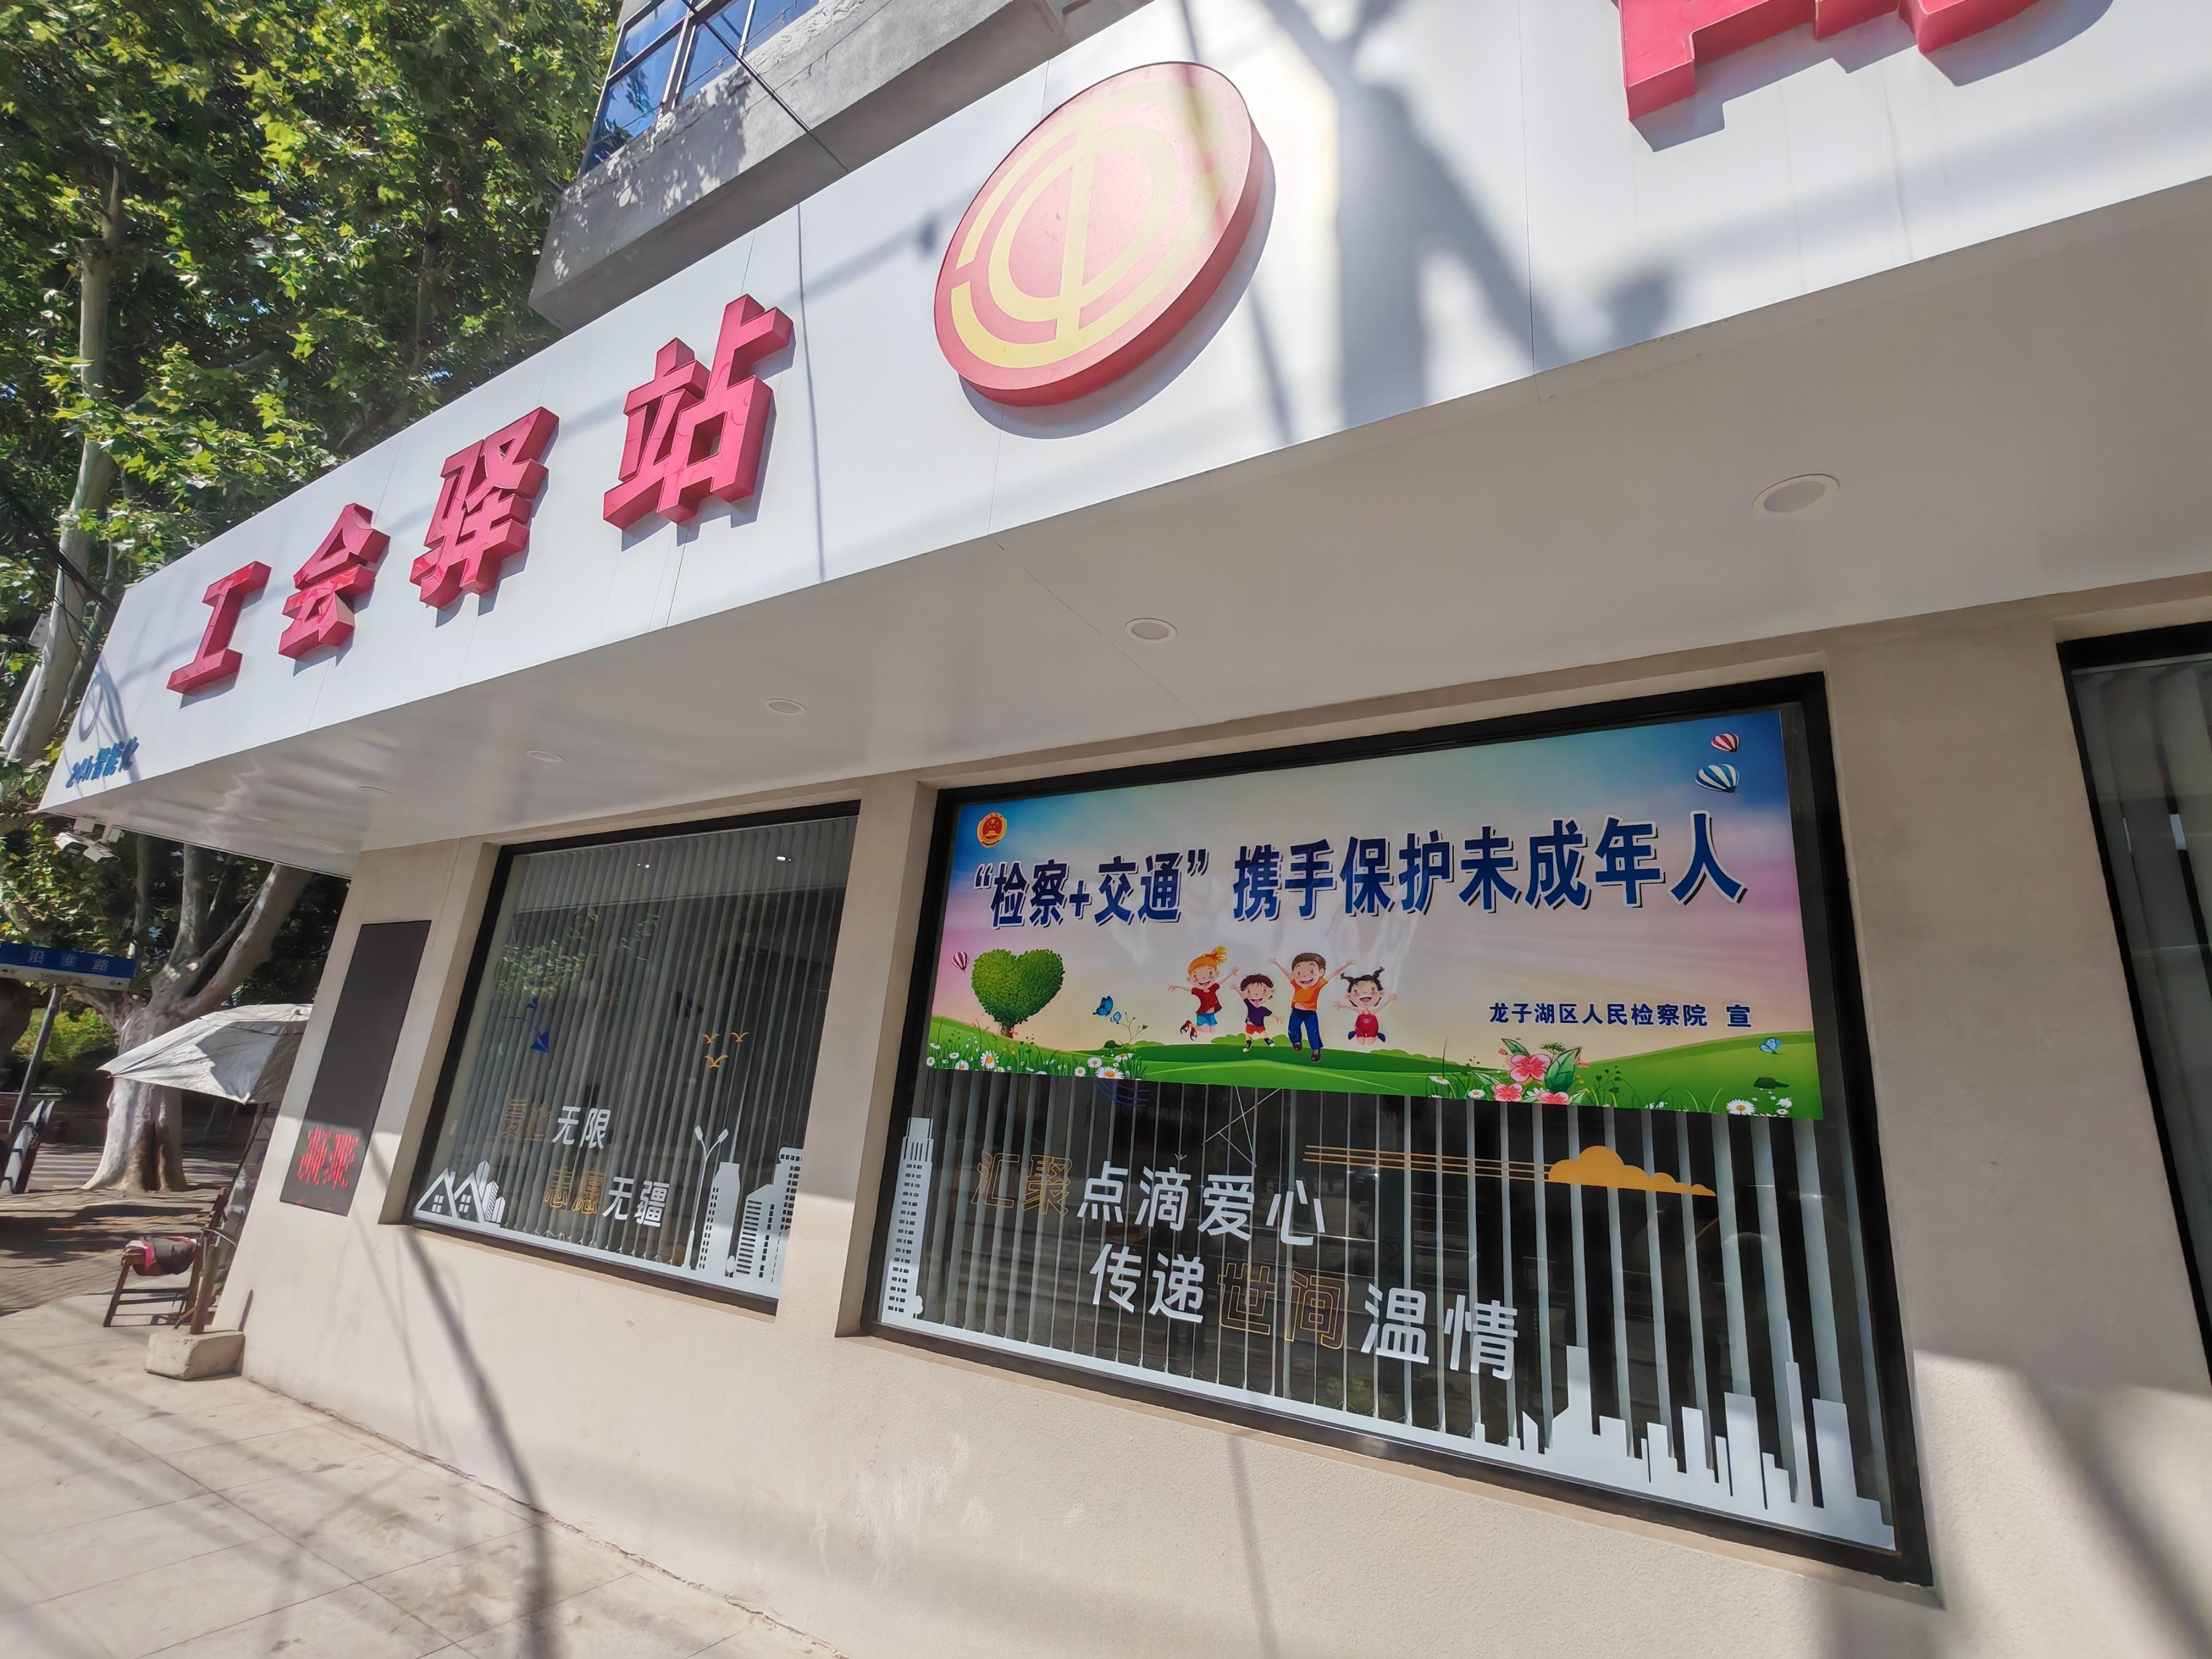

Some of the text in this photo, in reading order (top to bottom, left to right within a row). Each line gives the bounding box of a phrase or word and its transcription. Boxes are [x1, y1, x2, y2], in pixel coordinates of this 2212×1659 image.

[166, 294, 794, 694] 工会驿站
[1233, 810, 1747, 922] 携手保护未成年人
[1489, 1002, 1752, 1029] 龙子湖区人民检察院 宣
